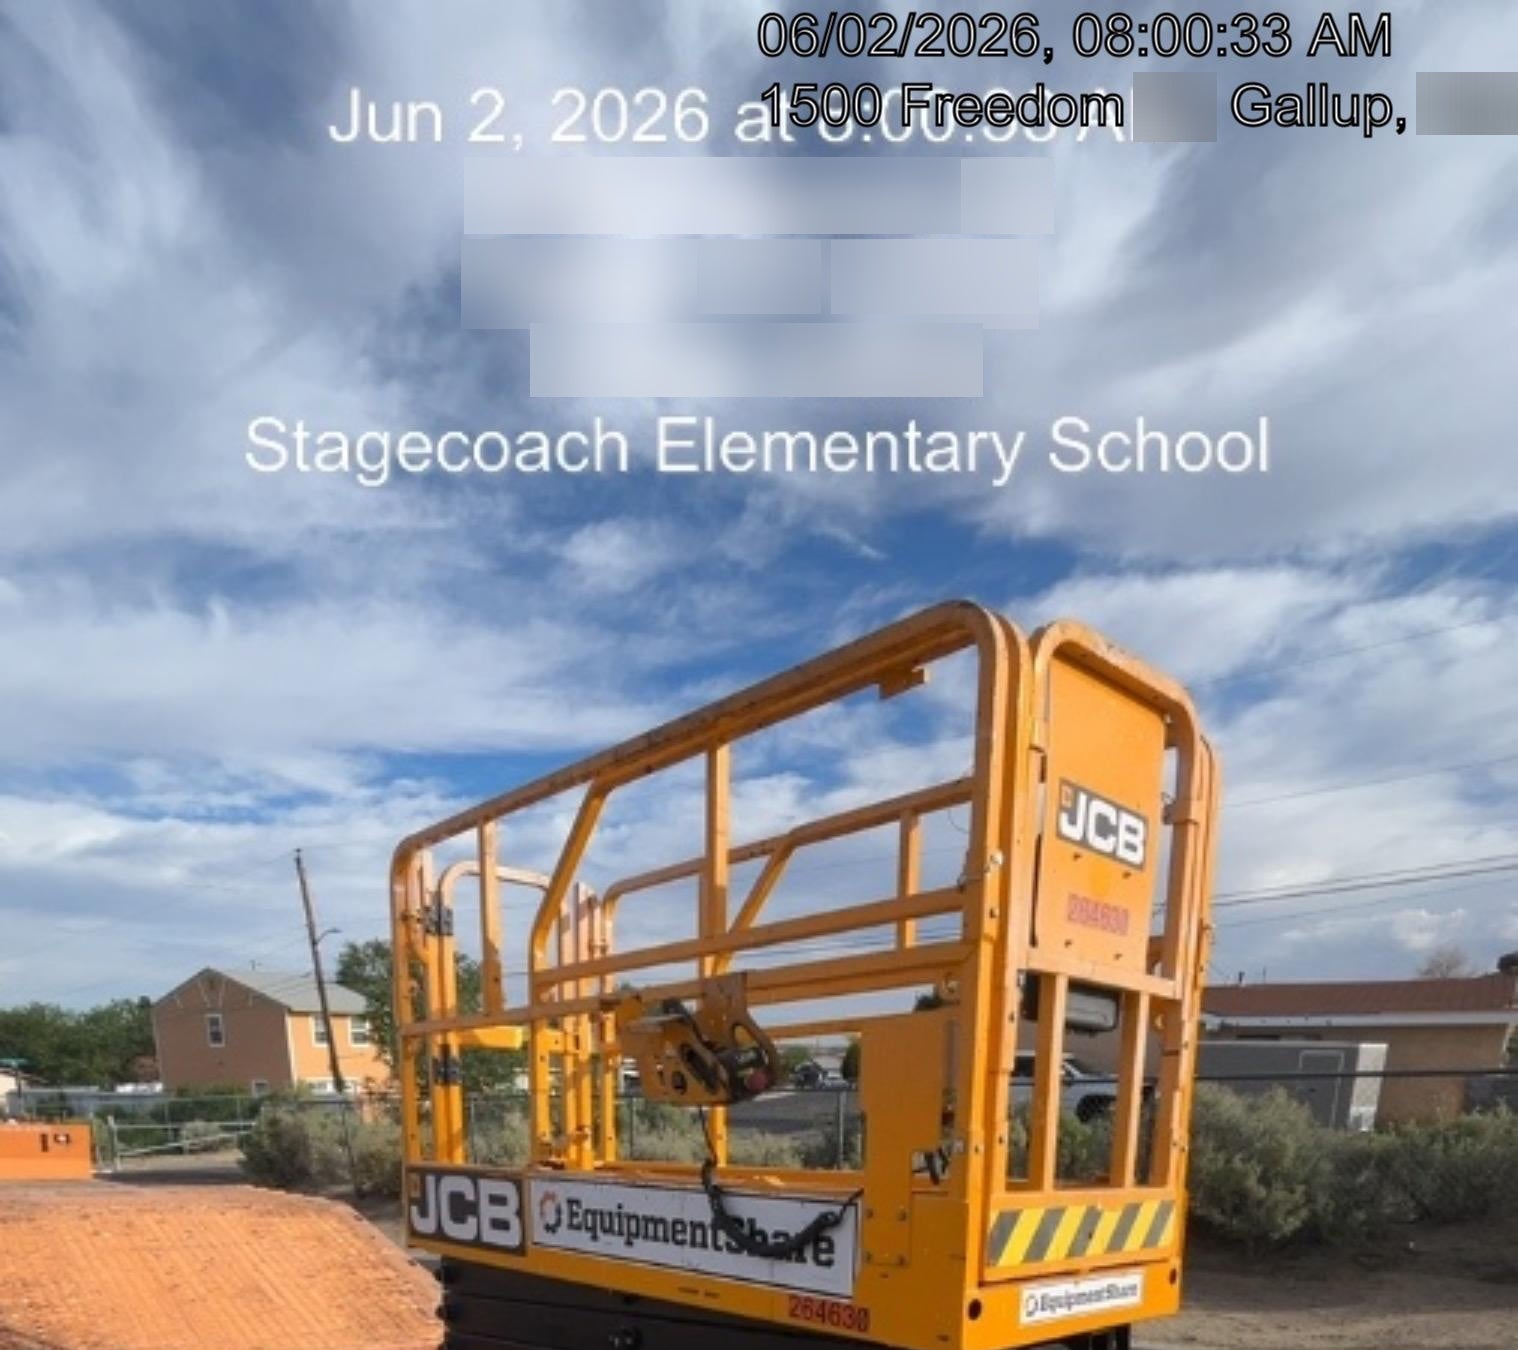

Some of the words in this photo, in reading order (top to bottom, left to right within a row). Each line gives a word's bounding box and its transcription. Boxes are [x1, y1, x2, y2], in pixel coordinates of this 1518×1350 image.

[1058, 791, 1146, 866] JCB
[410, 1173, 522, 1248] JCB
[789, 1295, 871, 1332] 264630
